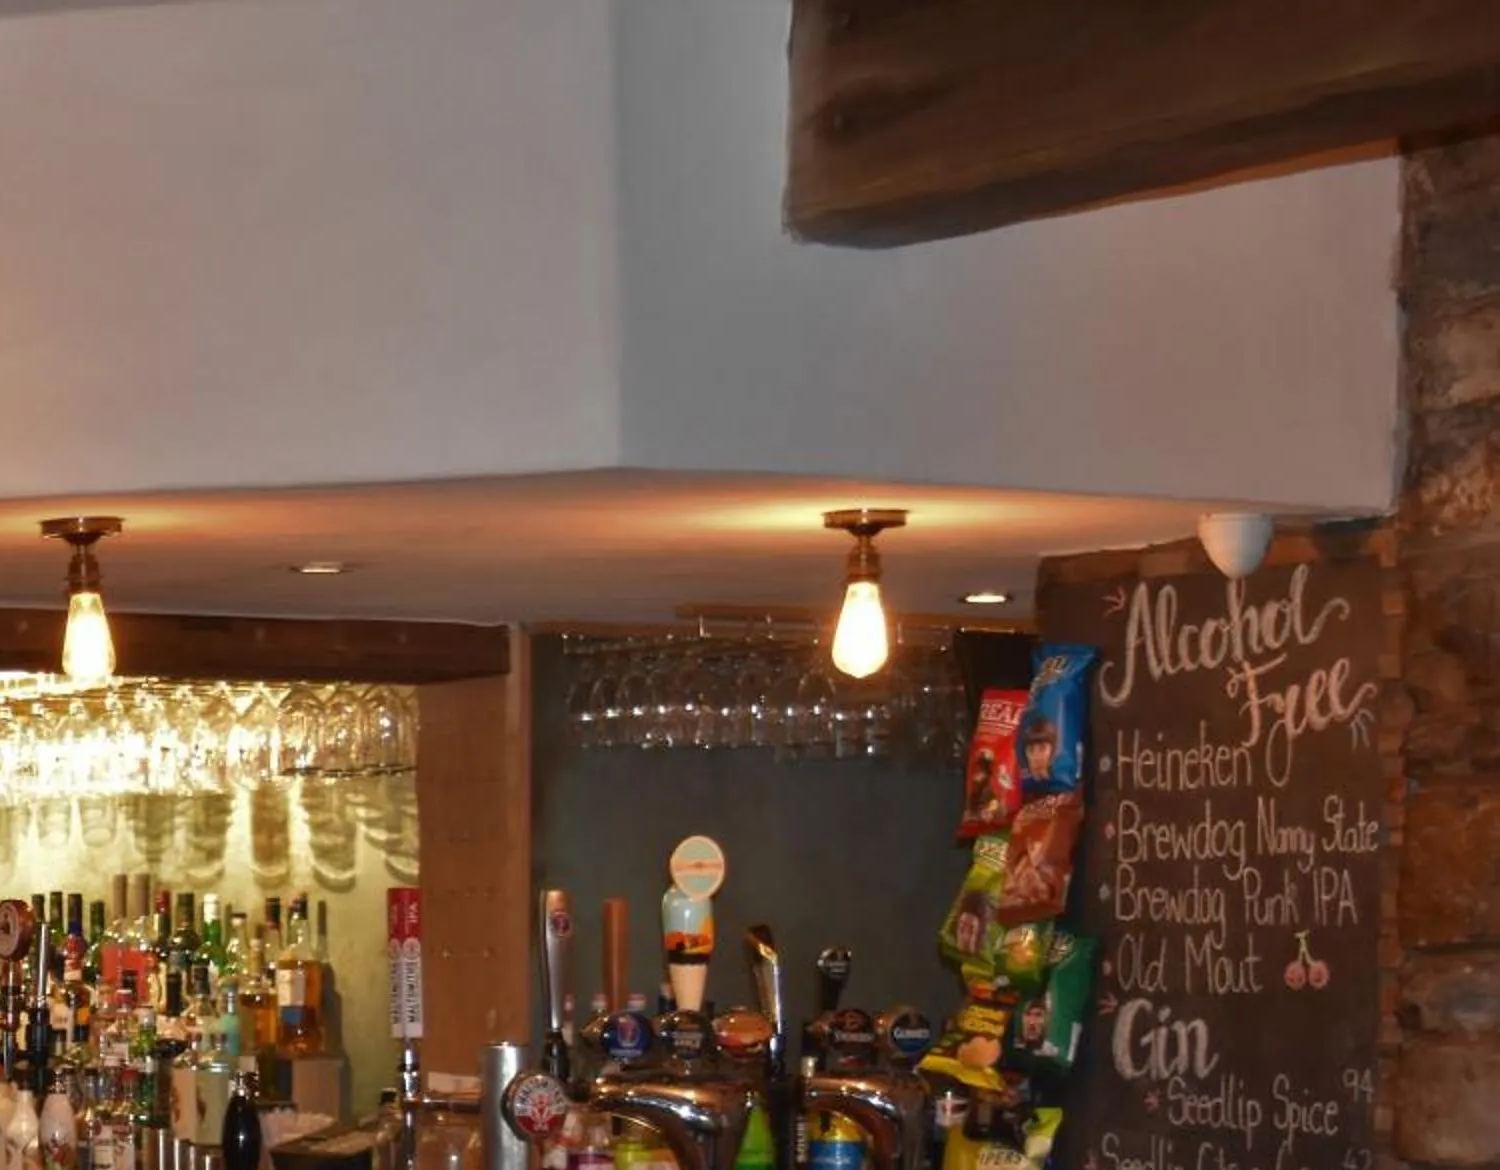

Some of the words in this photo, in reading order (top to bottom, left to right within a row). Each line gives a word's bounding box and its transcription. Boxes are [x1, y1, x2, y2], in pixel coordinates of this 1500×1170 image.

[1100, 564, 1349, 706] Alcohol
[1118, 720, 1252, 791] Heineken
[1226, 654, 1377, 787] Free
[1118, 800, 1245, 880] Brewdog
[1322, 795, 1380, 853] State
[1115, 864, 1225, 949] Brewdog
[1243, 867, 1298, 925] Punk
[1313, 867, 1358, 927] IPA
[1118, 933, 1166, 991] Old
[1184, 931, 1263, 994] Mout
[1112, 998, 1219, 1080] Gin
[1168, 1073, 1262, 1151] Seedlip
[1273, 1074, 1338, 1154] Spice
